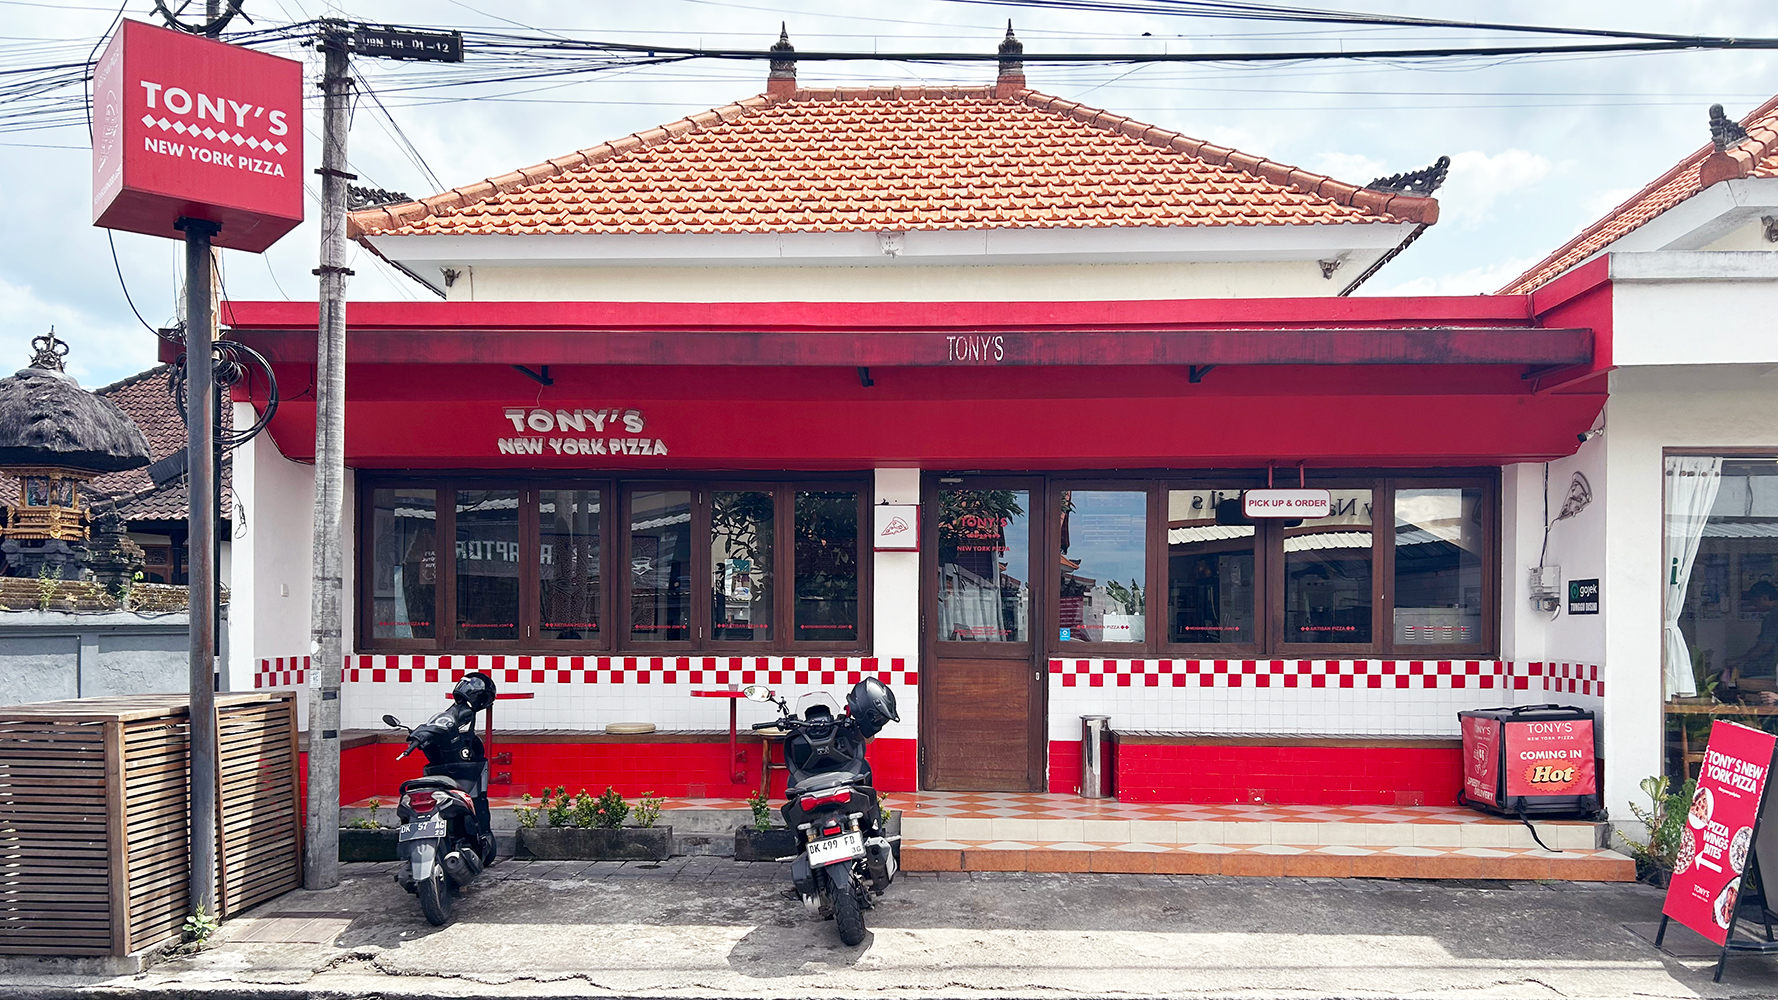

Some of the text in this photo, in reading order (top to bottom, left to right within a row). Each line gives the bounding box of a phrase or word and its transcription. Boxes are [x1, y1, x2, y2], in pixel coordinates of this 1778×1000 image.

[140, 80, 288, 136] TONY'S
[144, 137, 285, 178] NEW YORK PIZZA
[946, 335, 1004, 361] TONY'S
[504, 408, 645, 434] TONY'S
[497, 437, 668, 456] NEW YORK PIZZA
[1248, 499, 1327, 507] PICK UP & ORDER
[961, 517, 1008, 527] TONY'S
[1579, 583, 1598, 597] gojek
[1526, 722, 1573, 734] TONY'S
[1520, 749, 1582, 760] COMING IN
[1531, 765, 1575, 783] Hot
[1708, 750, 1764, 780] TONY'S NEW
[1707, 764, 1733, 785] YORK
[1731, 773, 1757, 794] PIZZA
[1707, 819, 1729, 839] PIZZA
[809, 843, 821, 854] DK
[844, 835, 855, 845] FD
[1703, 829, 1730, 851] WINGS
[1703, 842, 1723, 860] BITES
